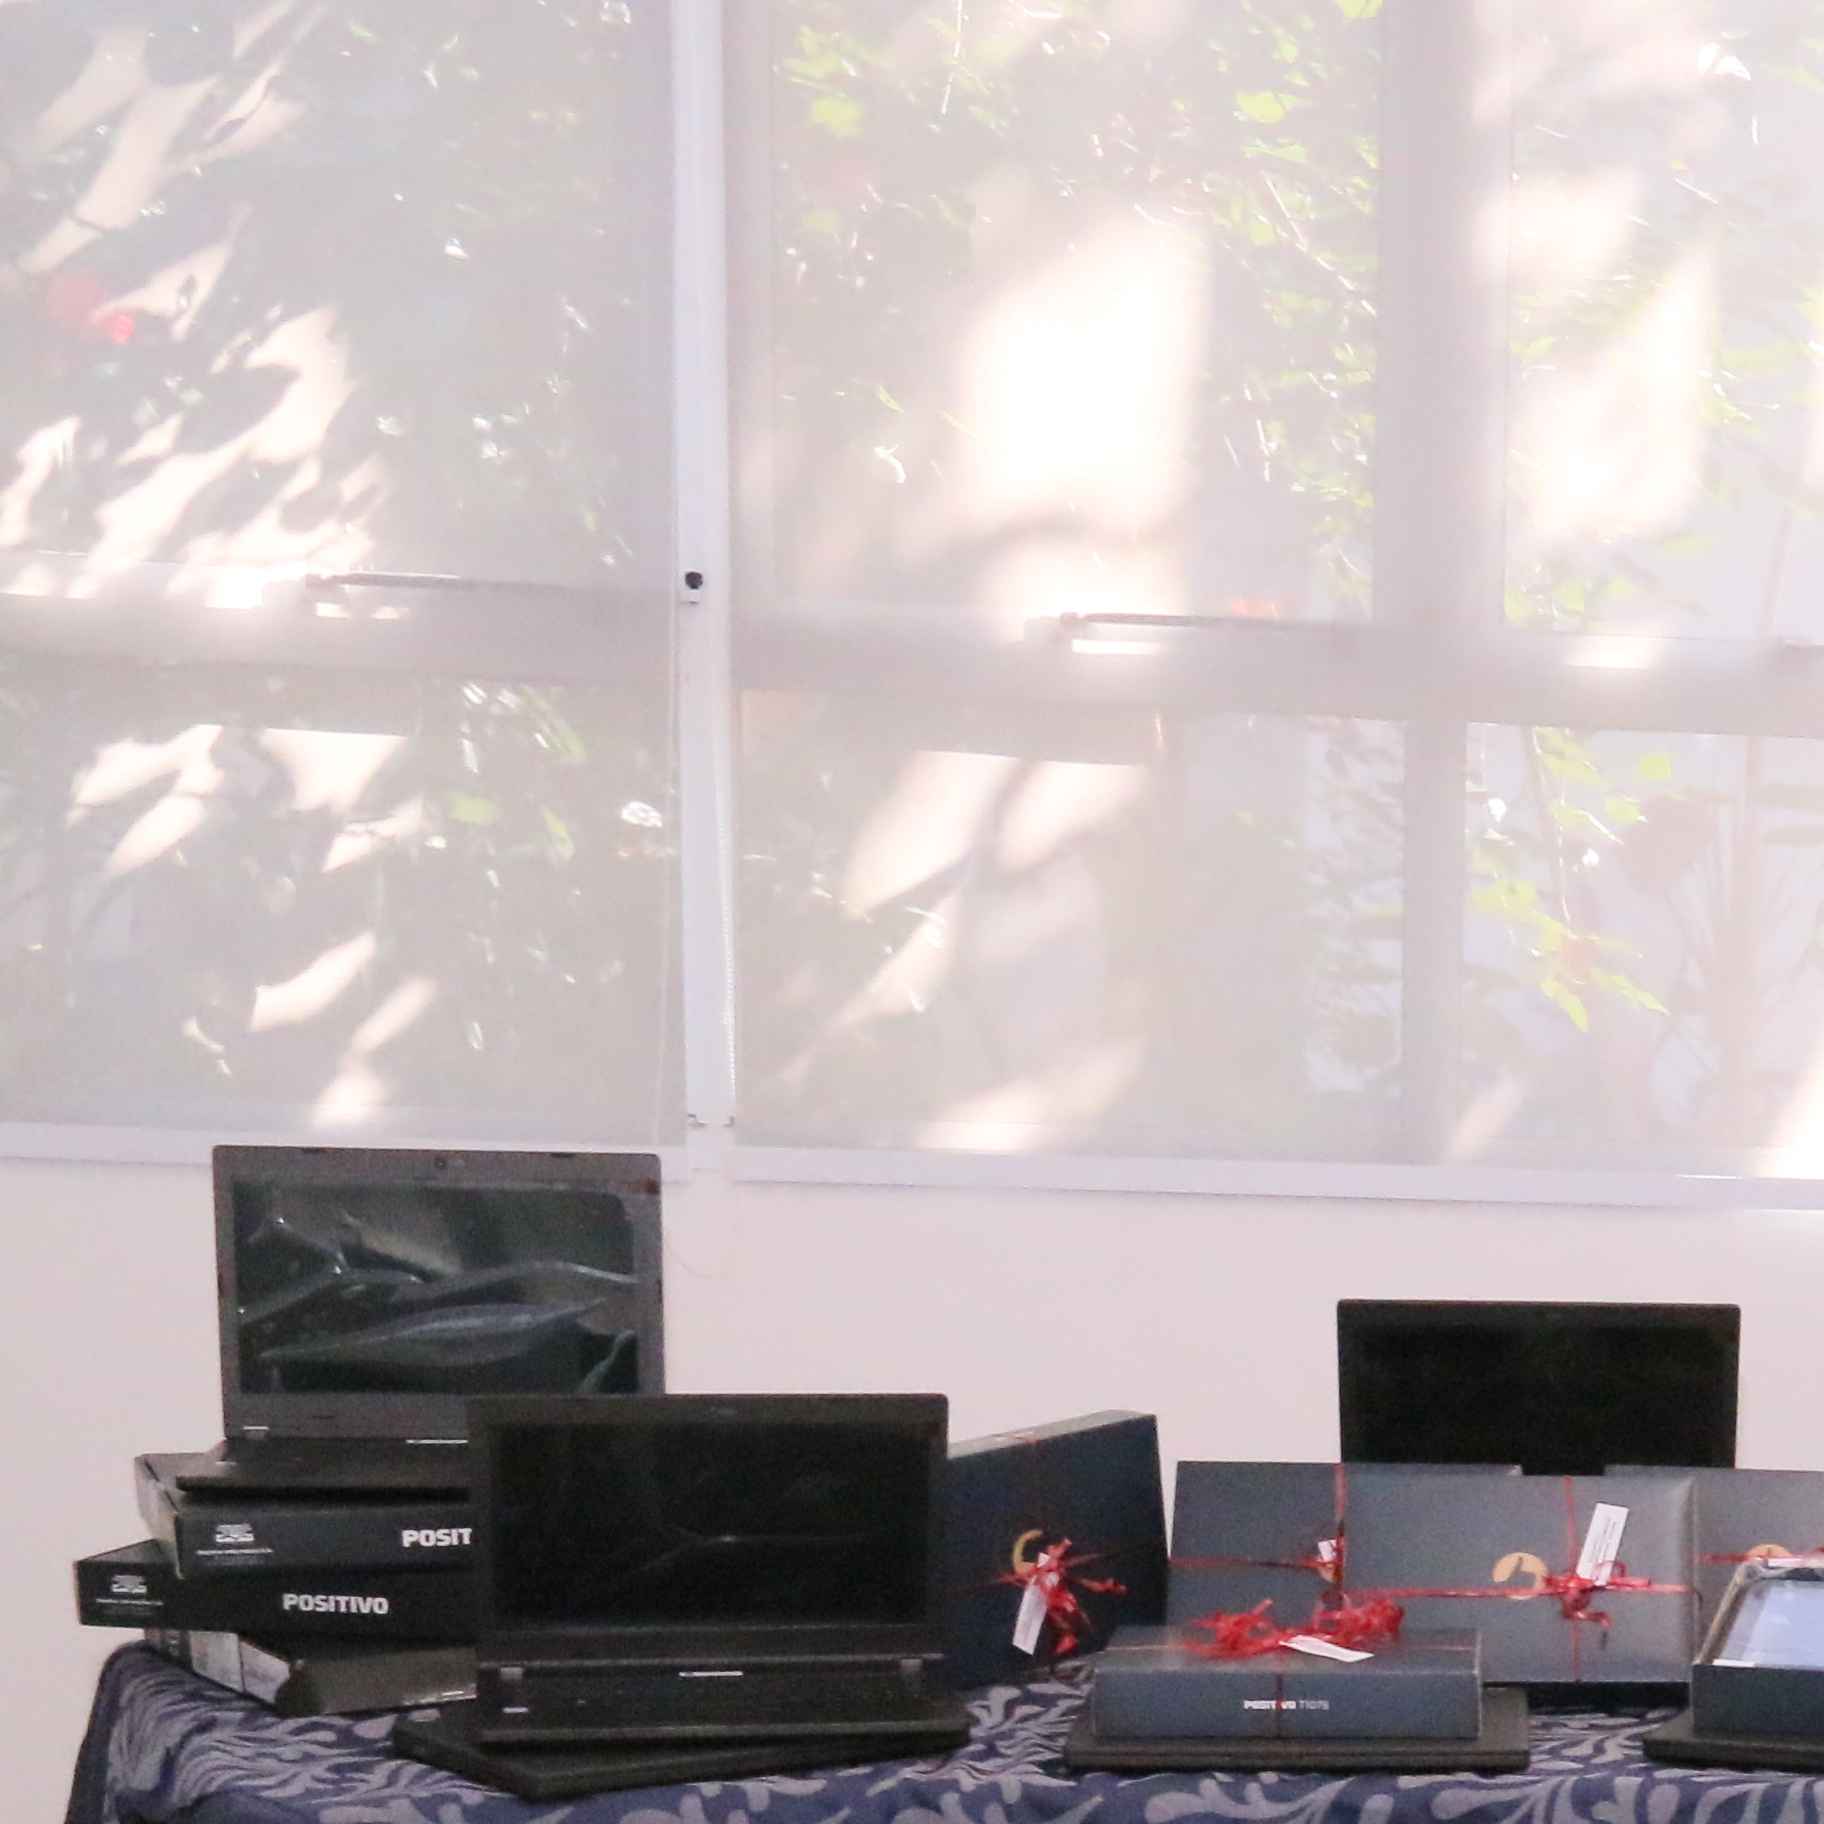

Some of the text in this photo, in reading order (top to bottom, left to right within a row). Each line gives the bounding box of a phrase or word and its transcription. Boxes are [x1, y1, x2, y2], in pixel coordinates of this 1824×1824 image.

[402, 1527, 472, 1548] POSIT
[282, 1593, 389, 1615] POSITIVO
[1243, 1700, 1297, 1710] POSITVO
